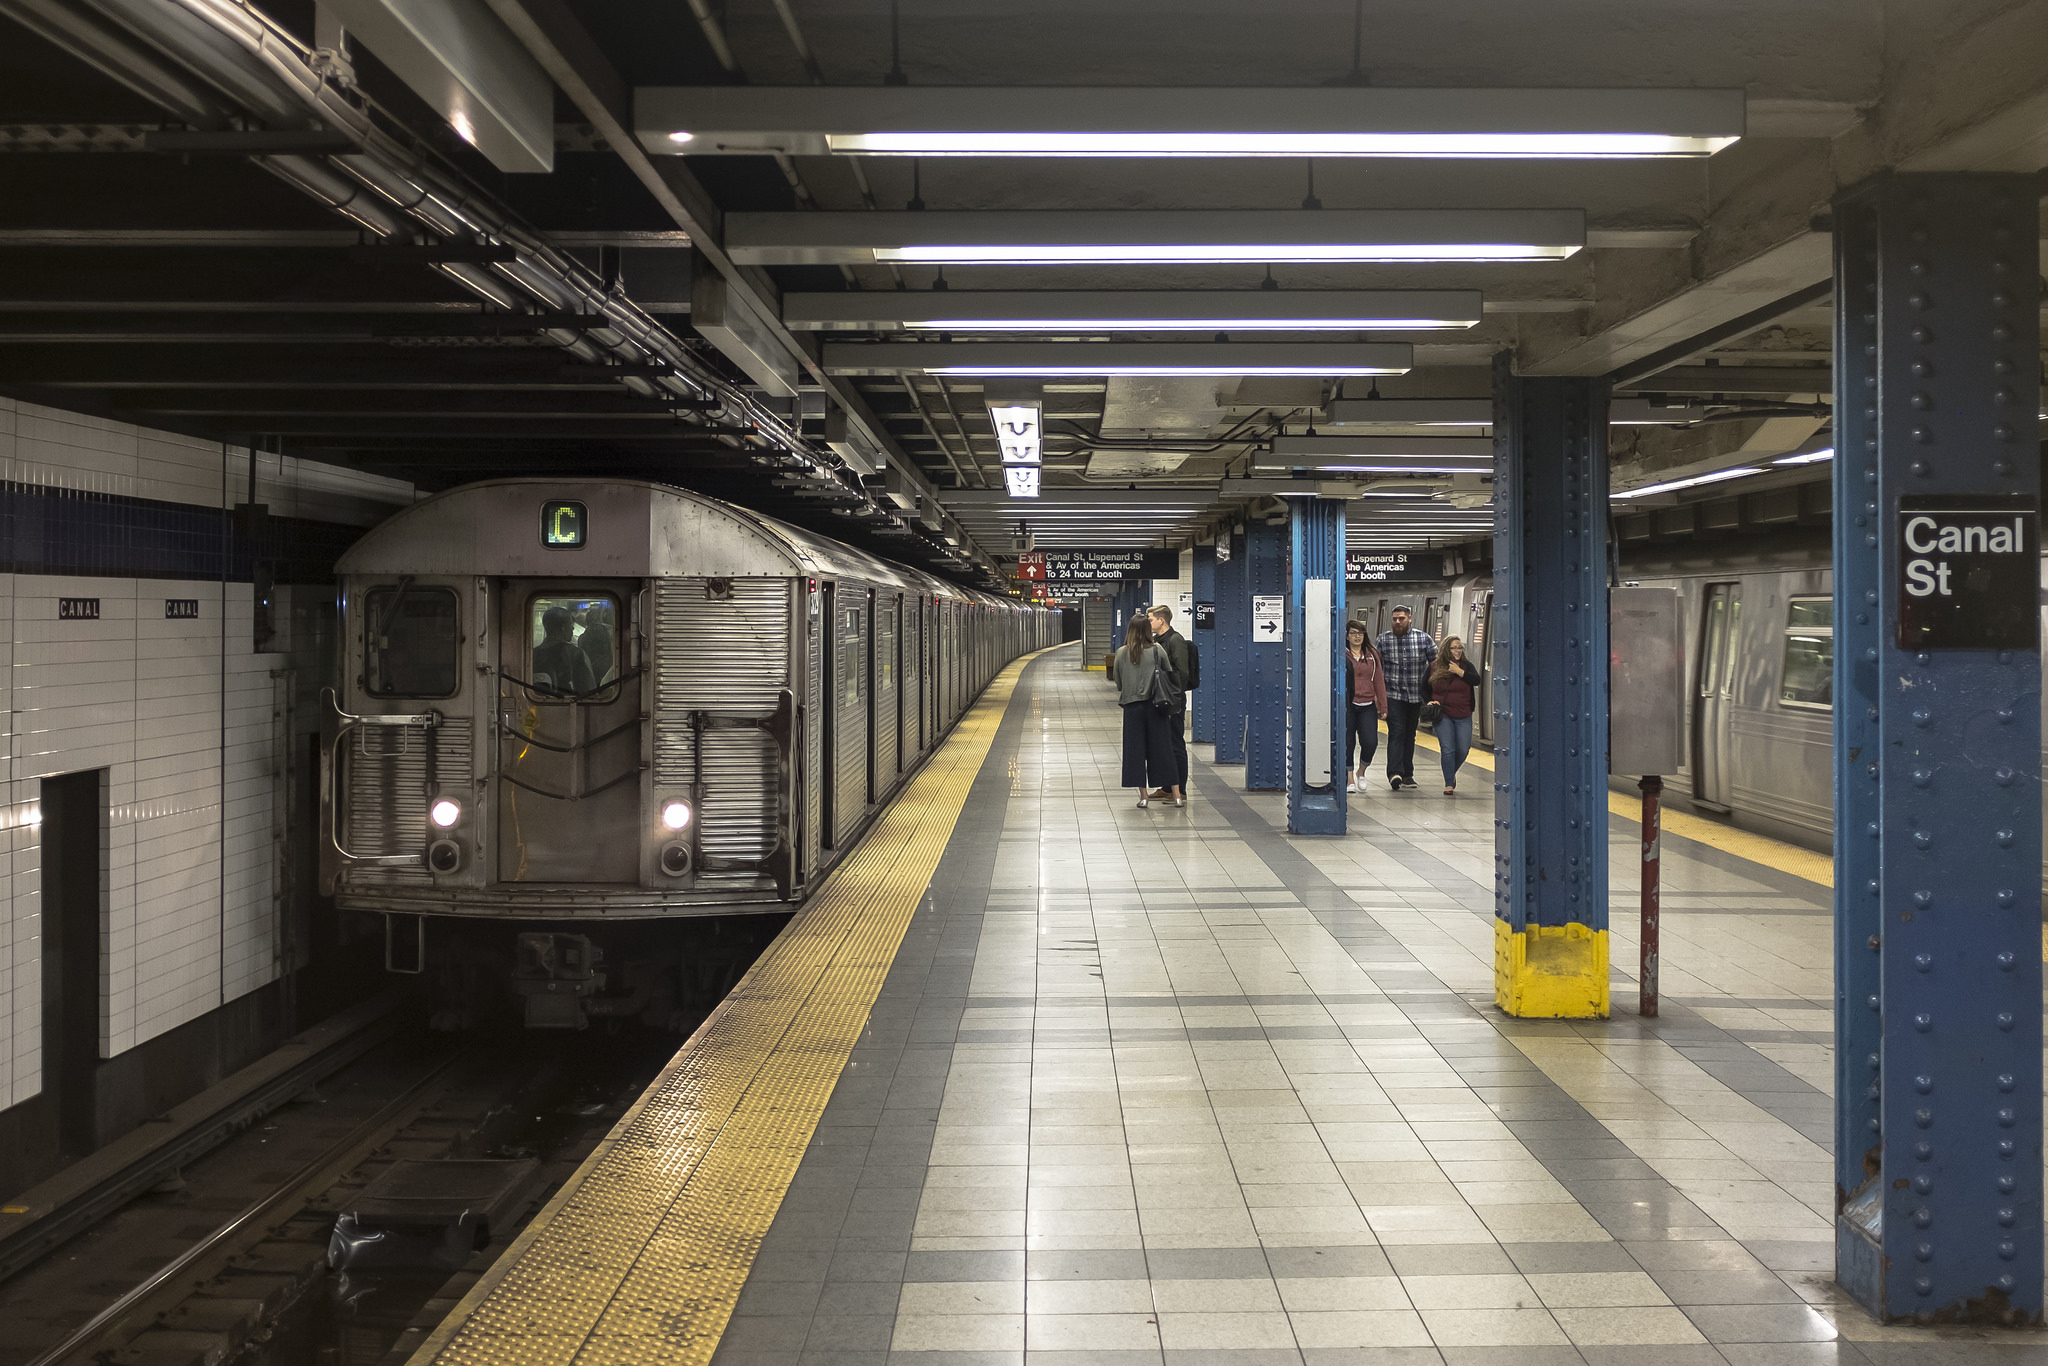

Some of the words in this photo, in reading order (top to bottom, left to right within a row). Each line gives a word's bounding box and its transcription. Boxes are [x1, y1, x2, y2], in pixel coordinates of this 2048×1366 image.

[555, 507, 575, 543] C
[1905, 516, 2023, 553] Canal
[1018, 553, 1043, 563] Exit
[1073, 553, 1085, 562] St,
[1089, 553, 1132, 562] Lispenard
[1352, 554, 1394, 563] Lispenard
[1397, 554, 1408, 562] St
[1101, 562, 1141, 570] Americas
[1347, 563, 1360, 571] the
[1364, 563, 1404, 571] Americas
[1046, 570, 1056, 578] To
[1060, 570, 1071, 578] 24
[1075, 570, 1093, 578] hour
[1097, 570, 1122, 578] booth
[1361, 572, 1386, 580] booth
[1905, 559, 1952, 596] St
[60, 600, 99, 617] CANAL
[166, 602, 198, 616] CANAL
[1196, 605, 1215, 613] Cana
